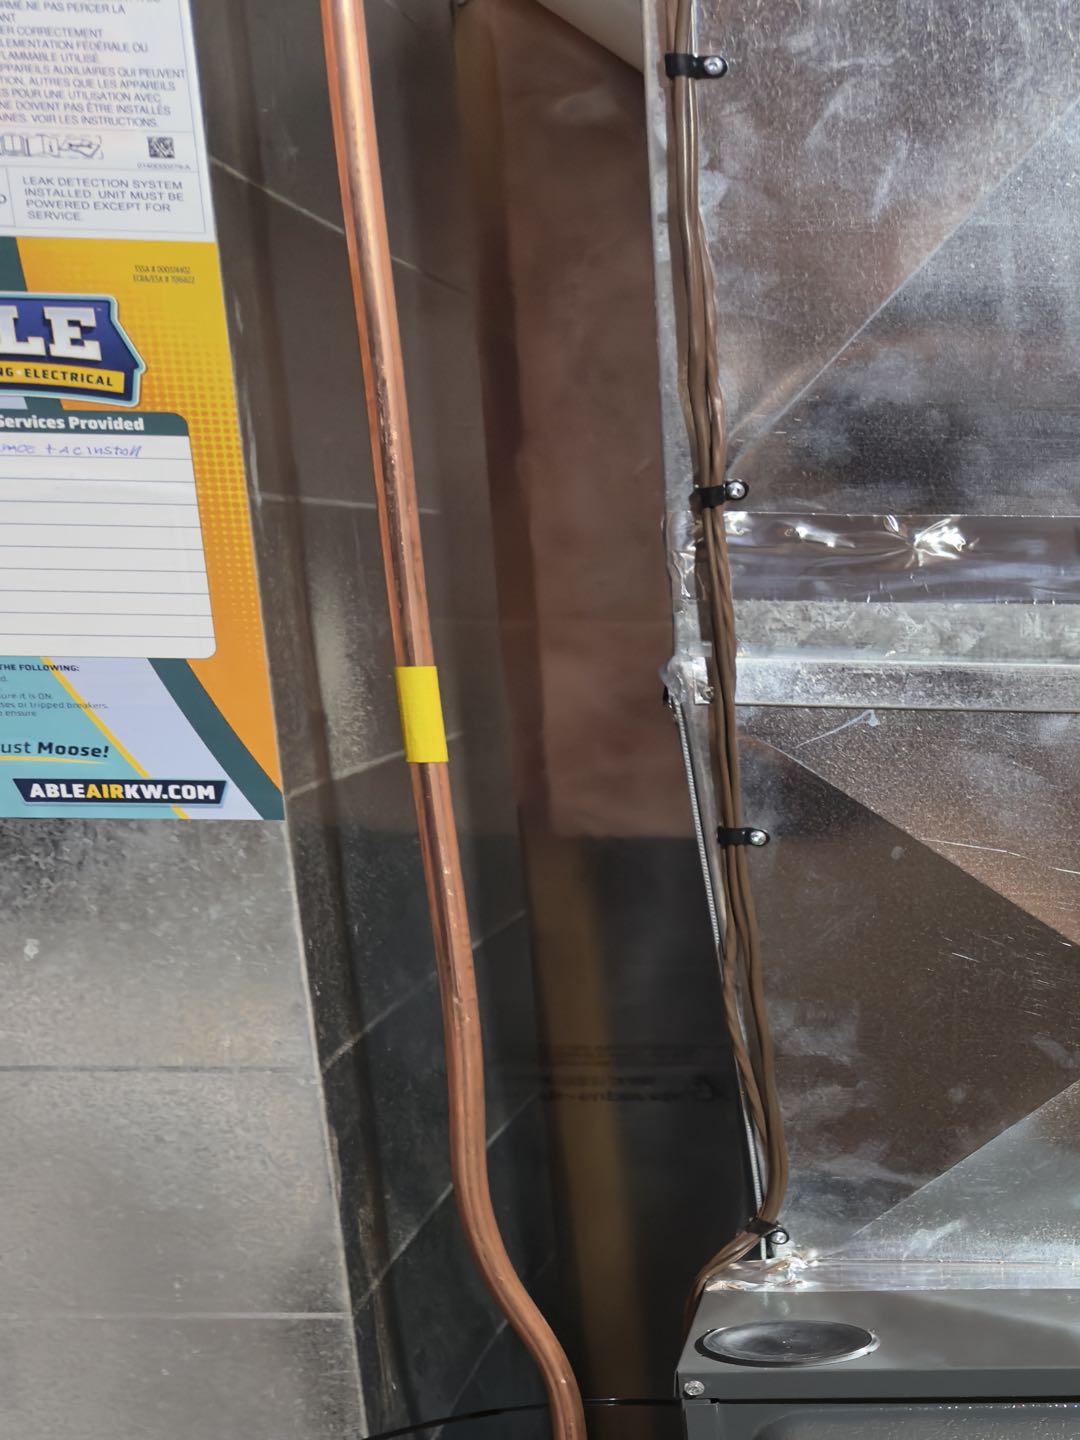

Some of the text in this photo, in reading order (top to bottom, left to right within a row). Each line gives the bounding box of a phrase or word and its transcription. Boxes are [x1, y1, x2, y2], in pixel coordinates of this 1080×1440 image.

[23, 176, 182, 190] LEAK DETECTION SYSTEM
[98, 190, 126, 200] UNIT
[130, 191, 164, 200] MUST
[169, 192, 183, 201] BE
[26, 199, 171, 212] POWERED EXCEPT FOR
[24, 368, 113, 386] ELECTRICAL
[0, 414, 145, 431] Services Provided
[37, 741, 109, 758] Moose!
[30, 783, 216, 800] ABLEAIRKW.COM
